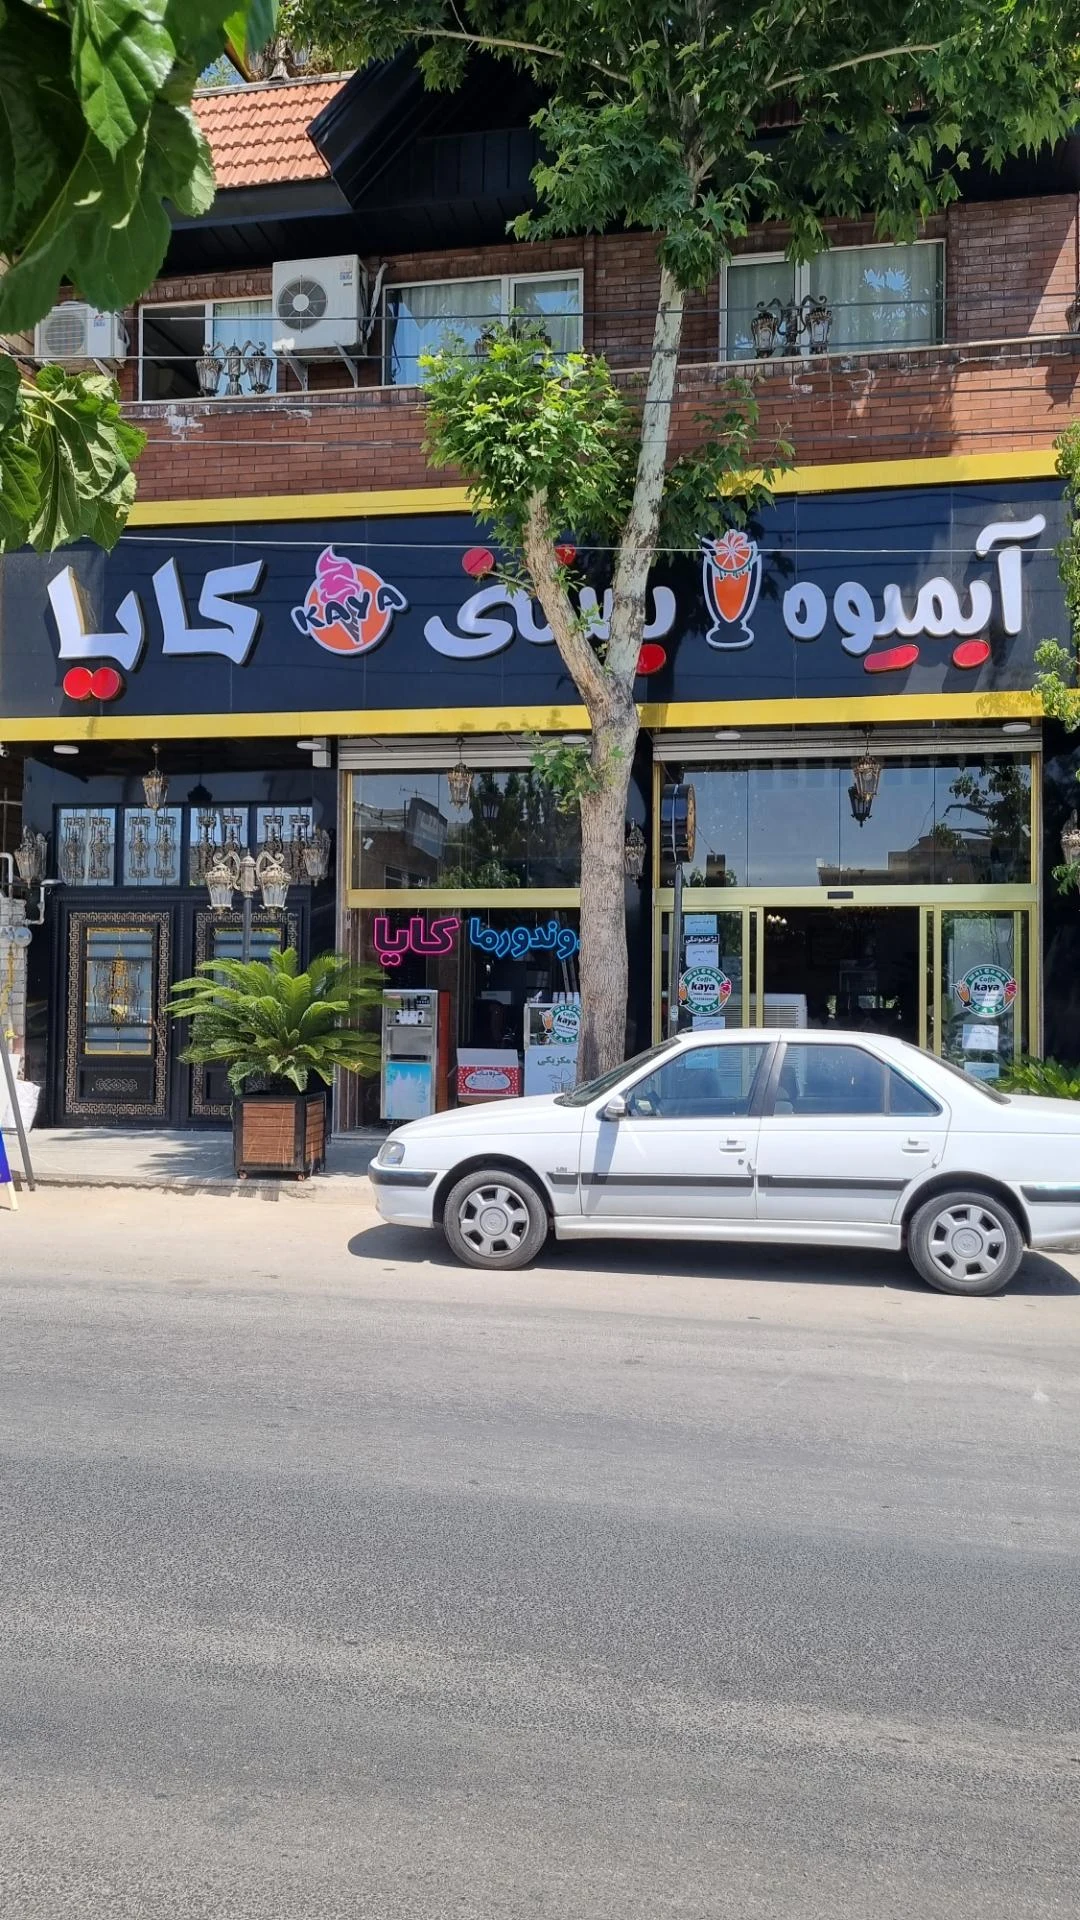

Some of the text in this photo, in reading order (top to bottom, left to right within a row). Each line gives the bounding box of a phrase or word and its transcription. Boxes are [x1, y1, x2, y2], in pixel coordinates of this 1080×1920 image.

[292, 585, 405, 633] KAYA
[782, 513, 1047, 673] آبمیوه
[46, 556, 265, 702] کایا
[373, 916, 580, 966] وندورما کایا
[691, 982, 715, 992] kaya
[974, 983, 1000, 992] kaya
[557, 1015, 577, 1026] kaya
